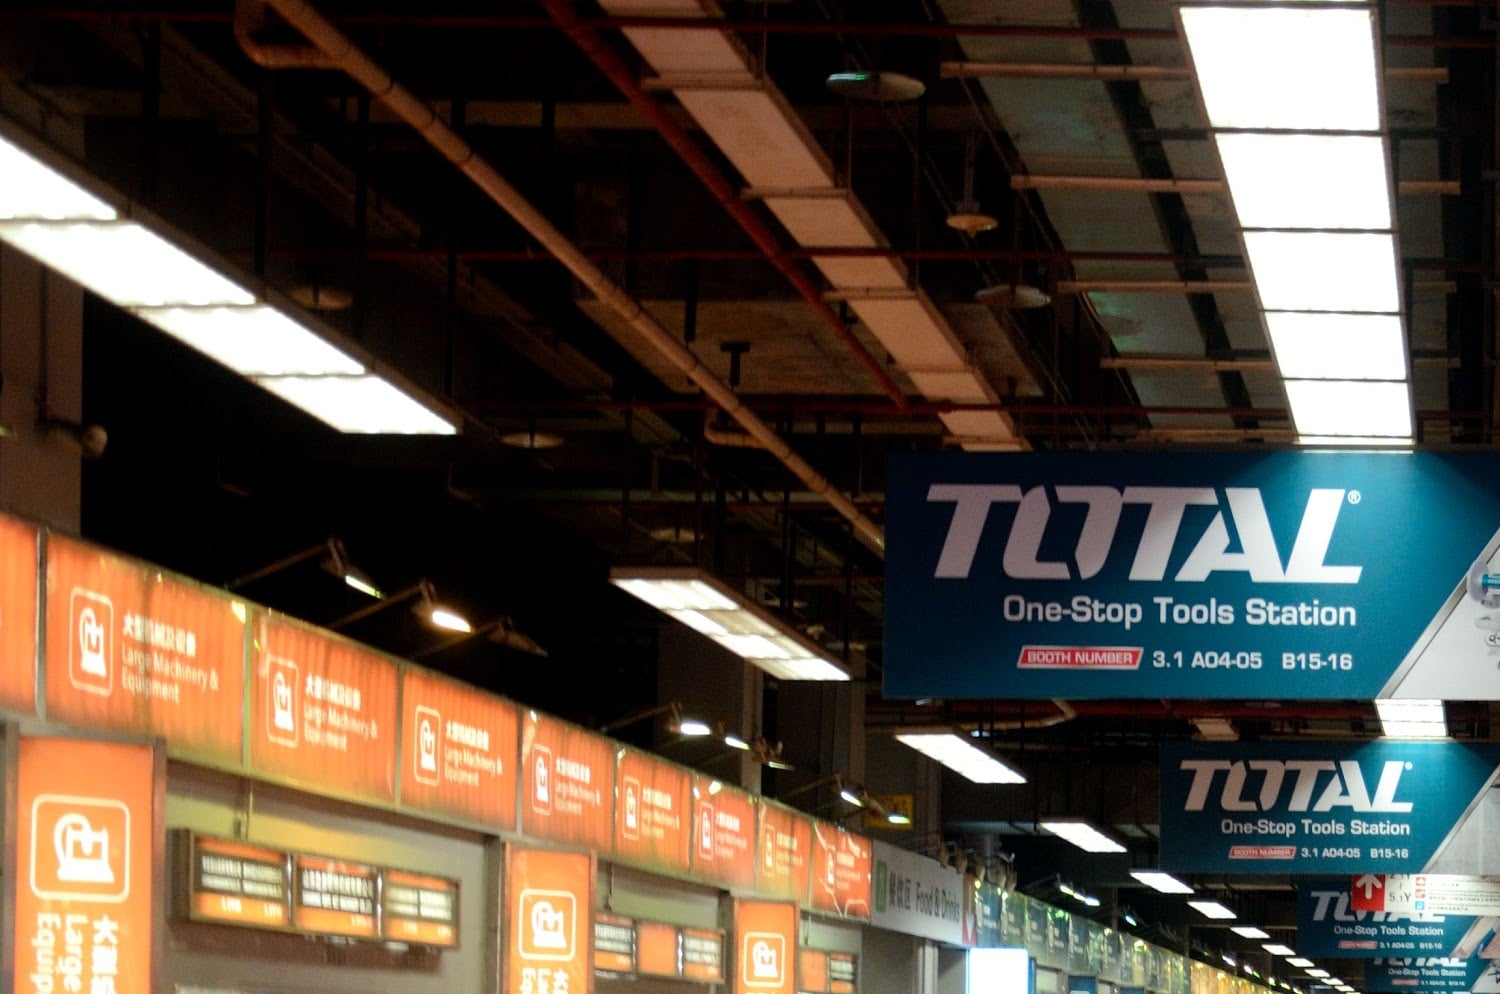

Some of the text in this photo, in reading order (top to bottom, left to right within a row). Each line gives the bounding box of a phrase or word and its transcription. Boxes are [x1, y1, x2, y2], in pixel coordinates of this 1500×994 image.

[926, 483, 1362, 583] TOTAL
[1003, 595, 1356, 629] One-Stop Tools Station
[122, 641, 151, 673] Large
[153, 651, 208, 692] Machinery
[1027, 650, 1133, 665] BOOTH NUMBER
[1152, 651, 1353, 671] 3.1 A04-05 B15-16
[122, 666, 180, 704] Equipment
[1180, 760, 1413, 813] TOTAL
[1221, 819, 1410, 838] One-Stop Tools Station
[1301, 848, 1318, 858] 3.1
[1370, 848, 1408, 859] B15-16
[1333, 925, 1444, 937] One-Stop Tools Station
[56, 913, 88, 993] Large
